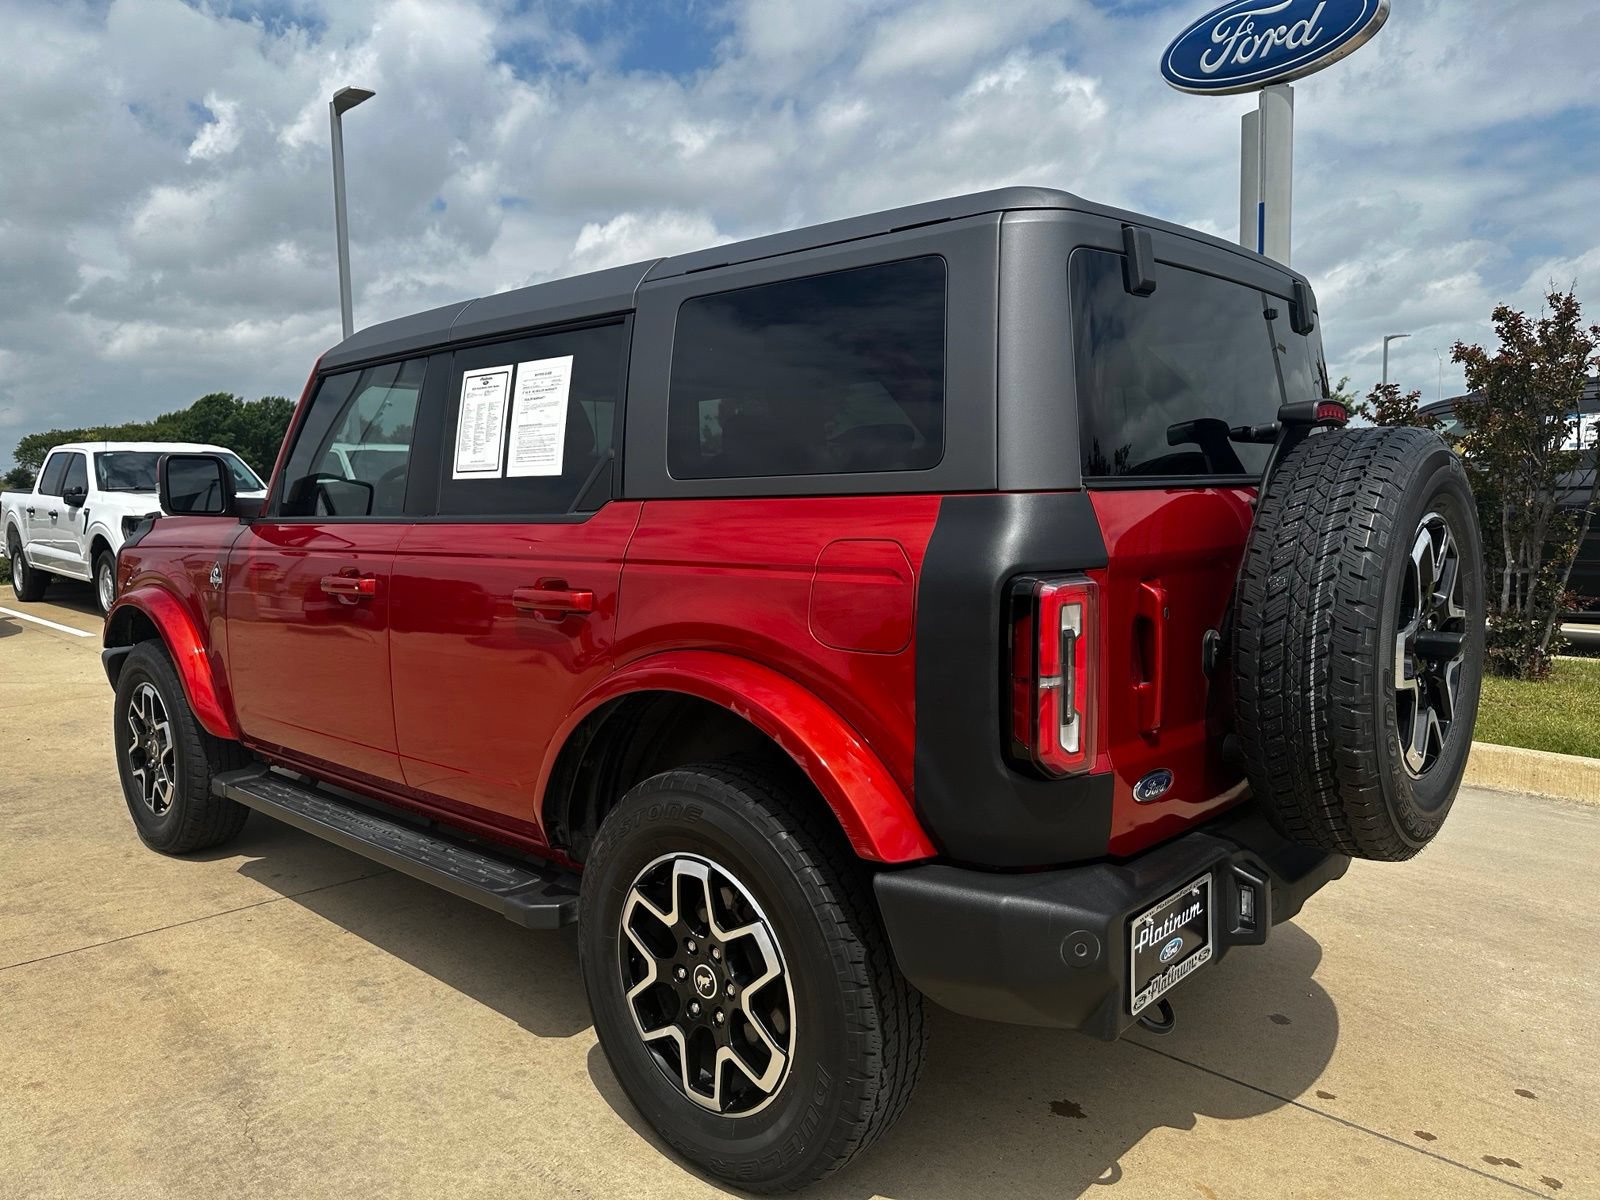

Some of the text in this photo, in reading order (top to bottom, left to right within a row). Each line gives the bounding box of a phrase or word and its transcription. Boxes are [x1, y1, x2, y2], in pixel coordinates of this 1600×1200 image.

[1200, 0, 1327, 74] Ford
[1144, 776, 1168, 798] Ford
[1134, 901, 1204, 954] Platinum
[1162, 940, 1180, 961] Ford
[1150, 955, 1198, 1000] Platinum
